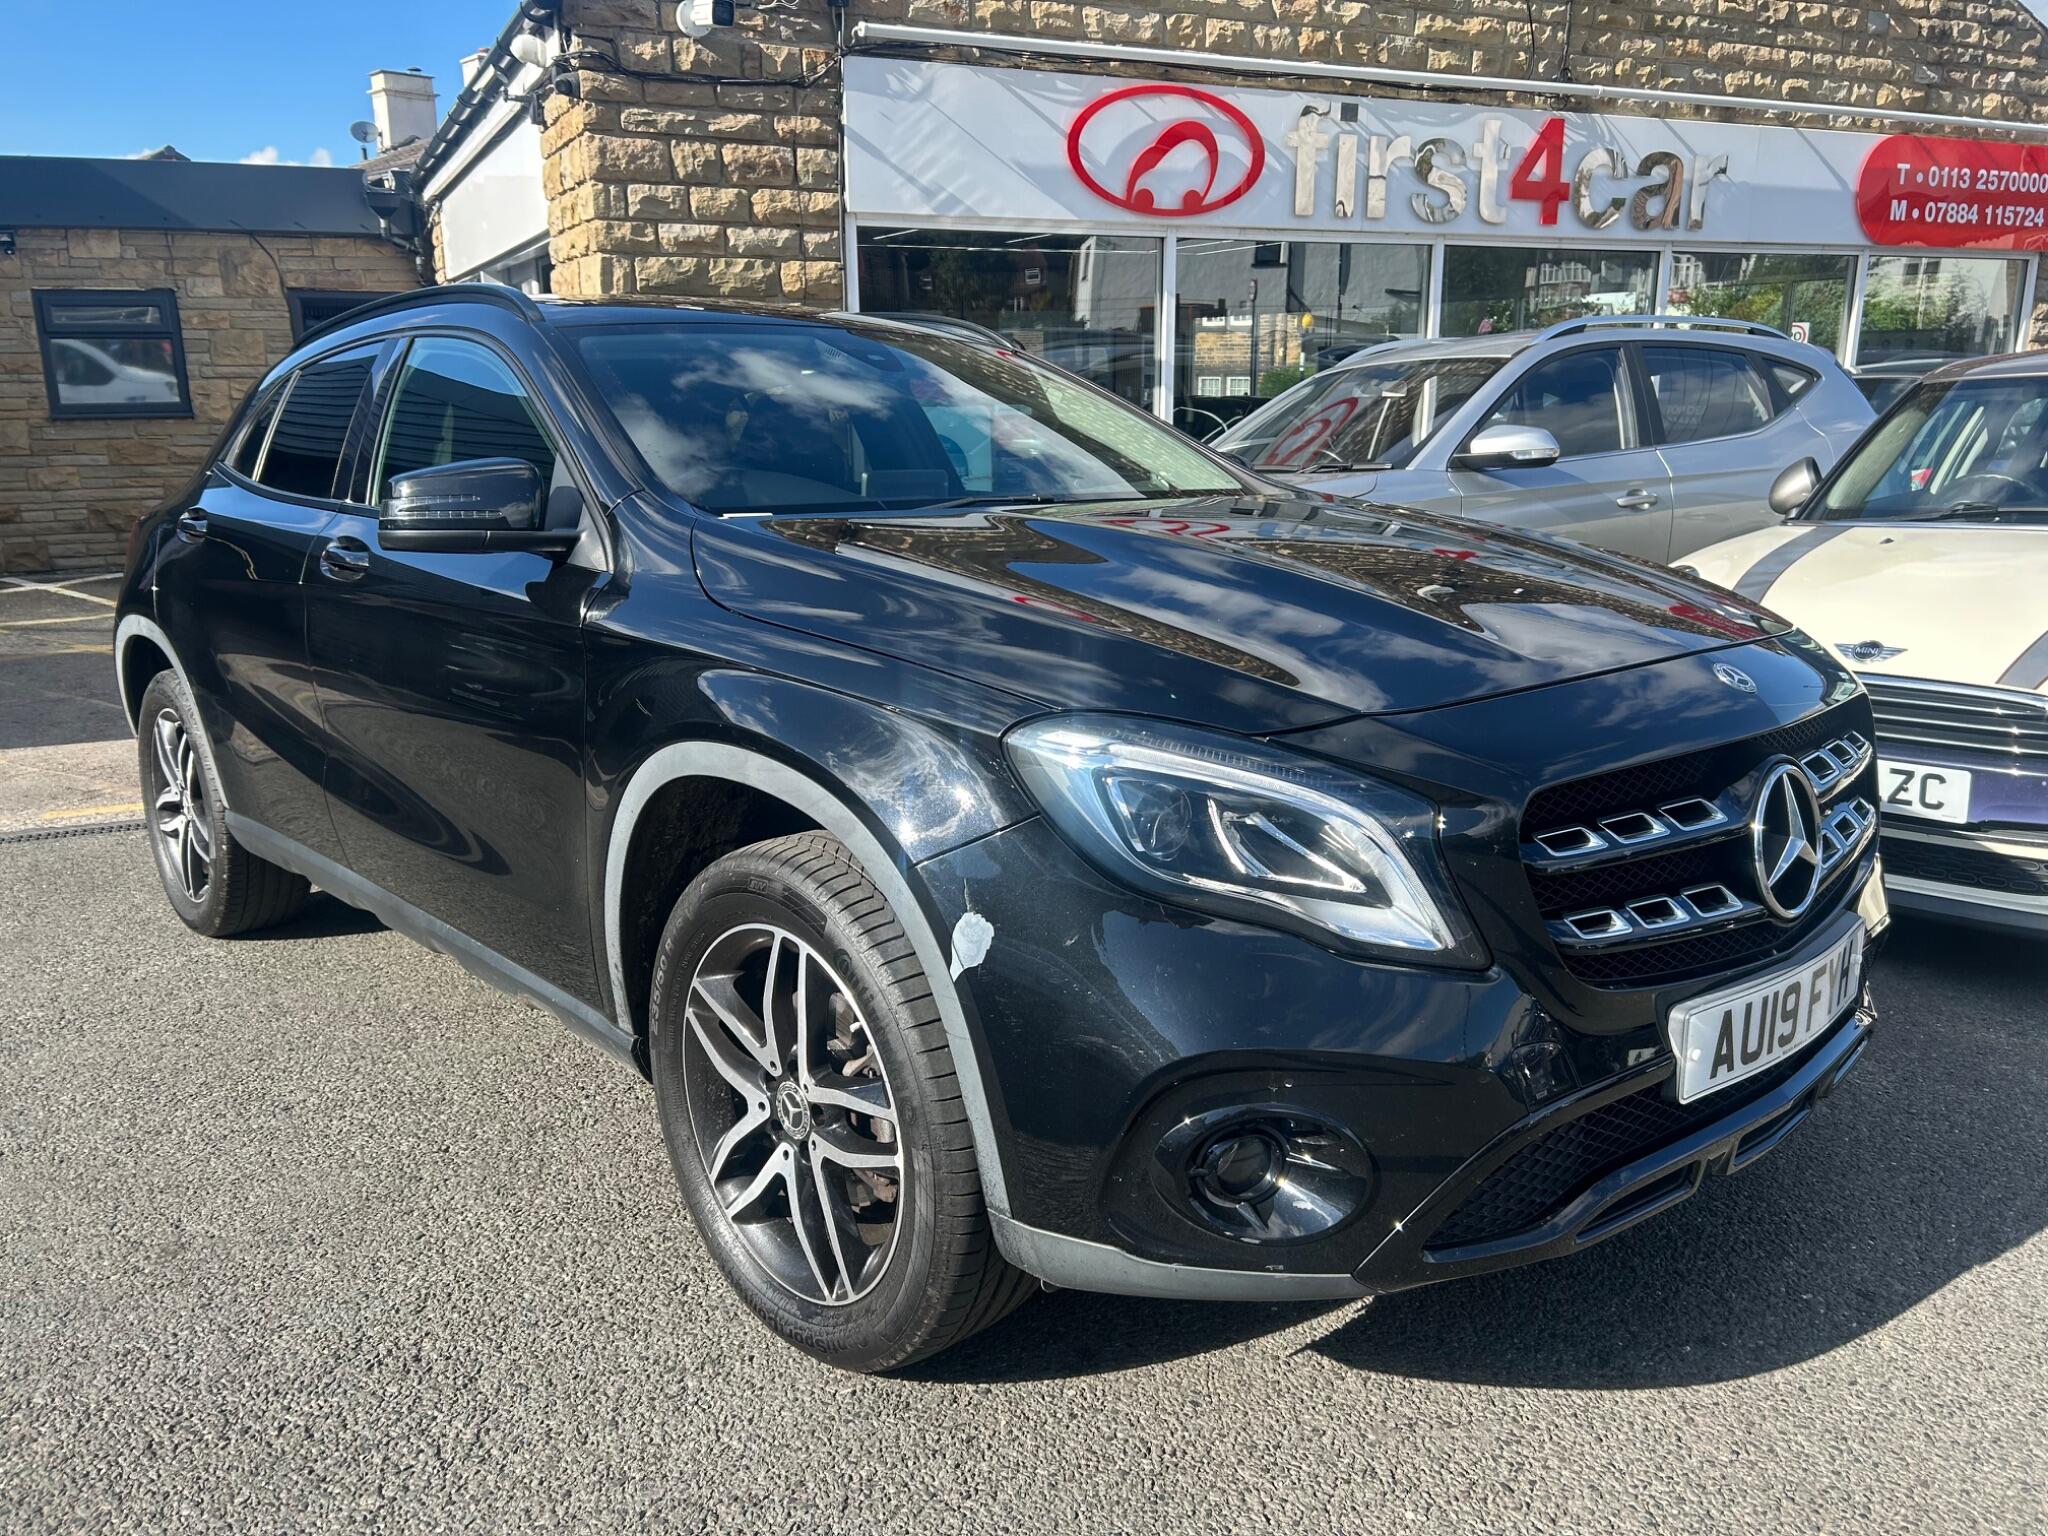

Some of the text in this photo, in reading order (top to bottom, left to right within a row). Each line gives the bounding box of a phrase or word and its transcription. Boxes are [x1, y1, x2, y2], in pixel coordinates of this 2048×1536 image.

[1285, 101, 1729, 231] first4car
[1928, 166, 1970, 189] 0113
[1976, 169, 2048, 193] 2570000
[1925, 202, 1978, 225] 07884
[1985, 205, 2044, 227] 115724
[1855, 646, 1879, 655] MINI
[1879, 767, 1947, 811] ZC
[1709, 940, 1854, 1080] AU19 FYH
